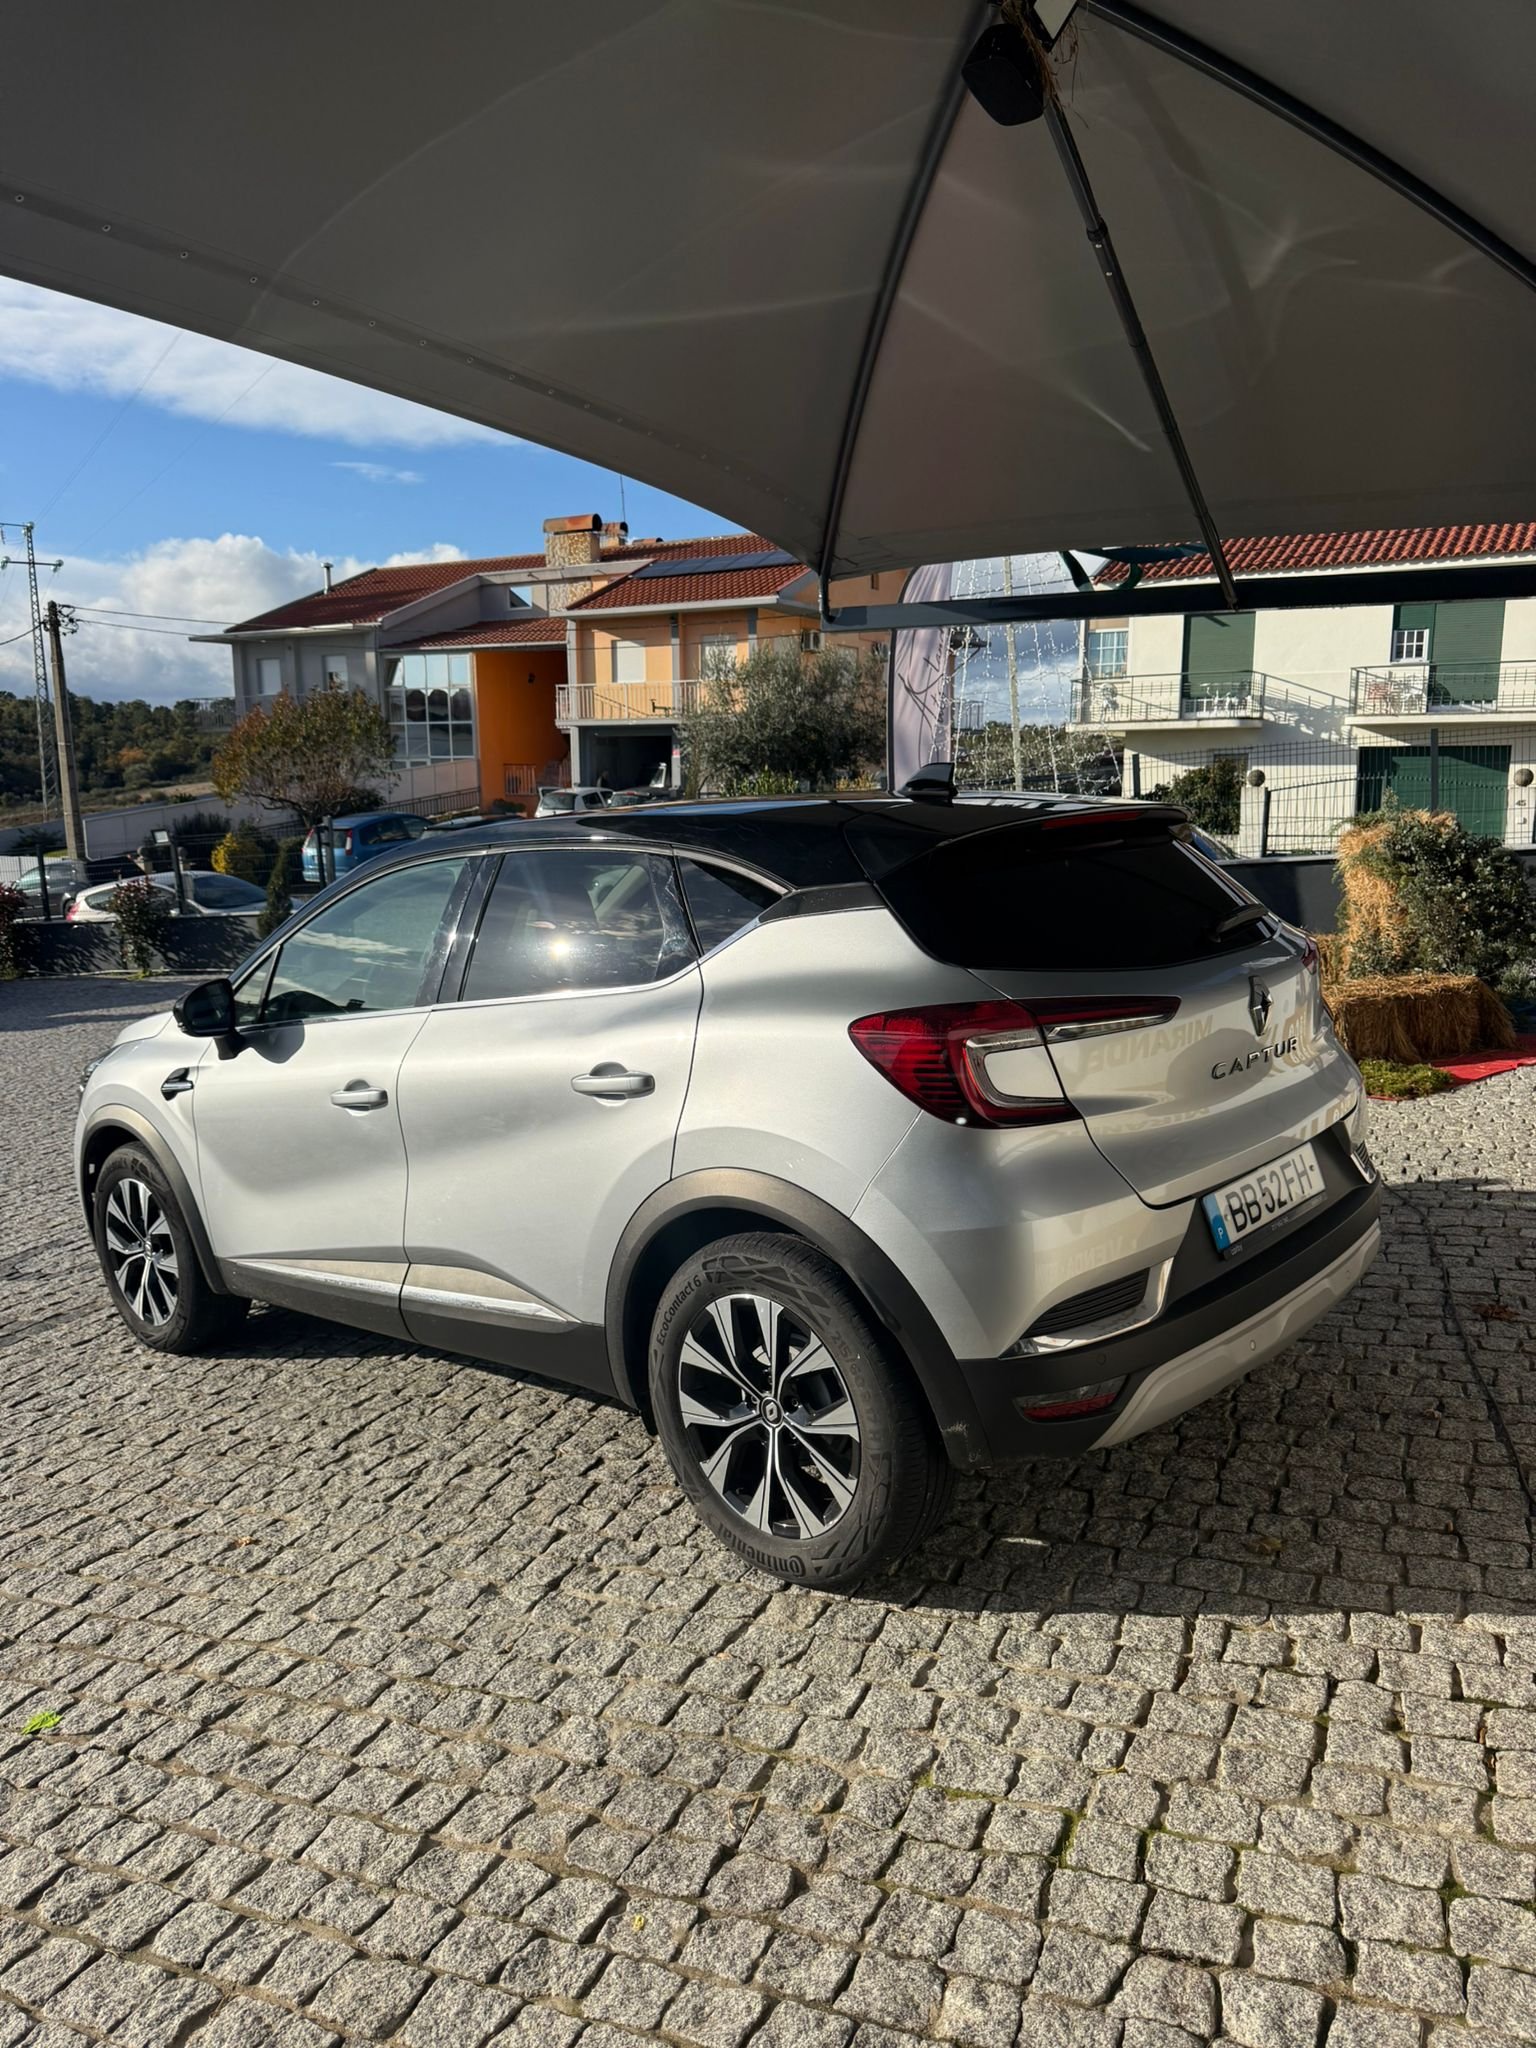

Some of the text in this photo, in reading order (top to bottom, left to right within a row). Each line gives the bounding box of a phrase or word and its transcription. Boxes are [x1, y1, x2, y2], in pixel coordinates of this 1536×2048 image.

[1211, 1036, 1297, 1080] CAPTUR
[1225, 1154, 1312, 1233] BB52FH
[1217, 1227, 1224, 1240] P
[657, 1275, 702, 1347] EcoContact 6
[718, 1523, 806, 1578] Continental
